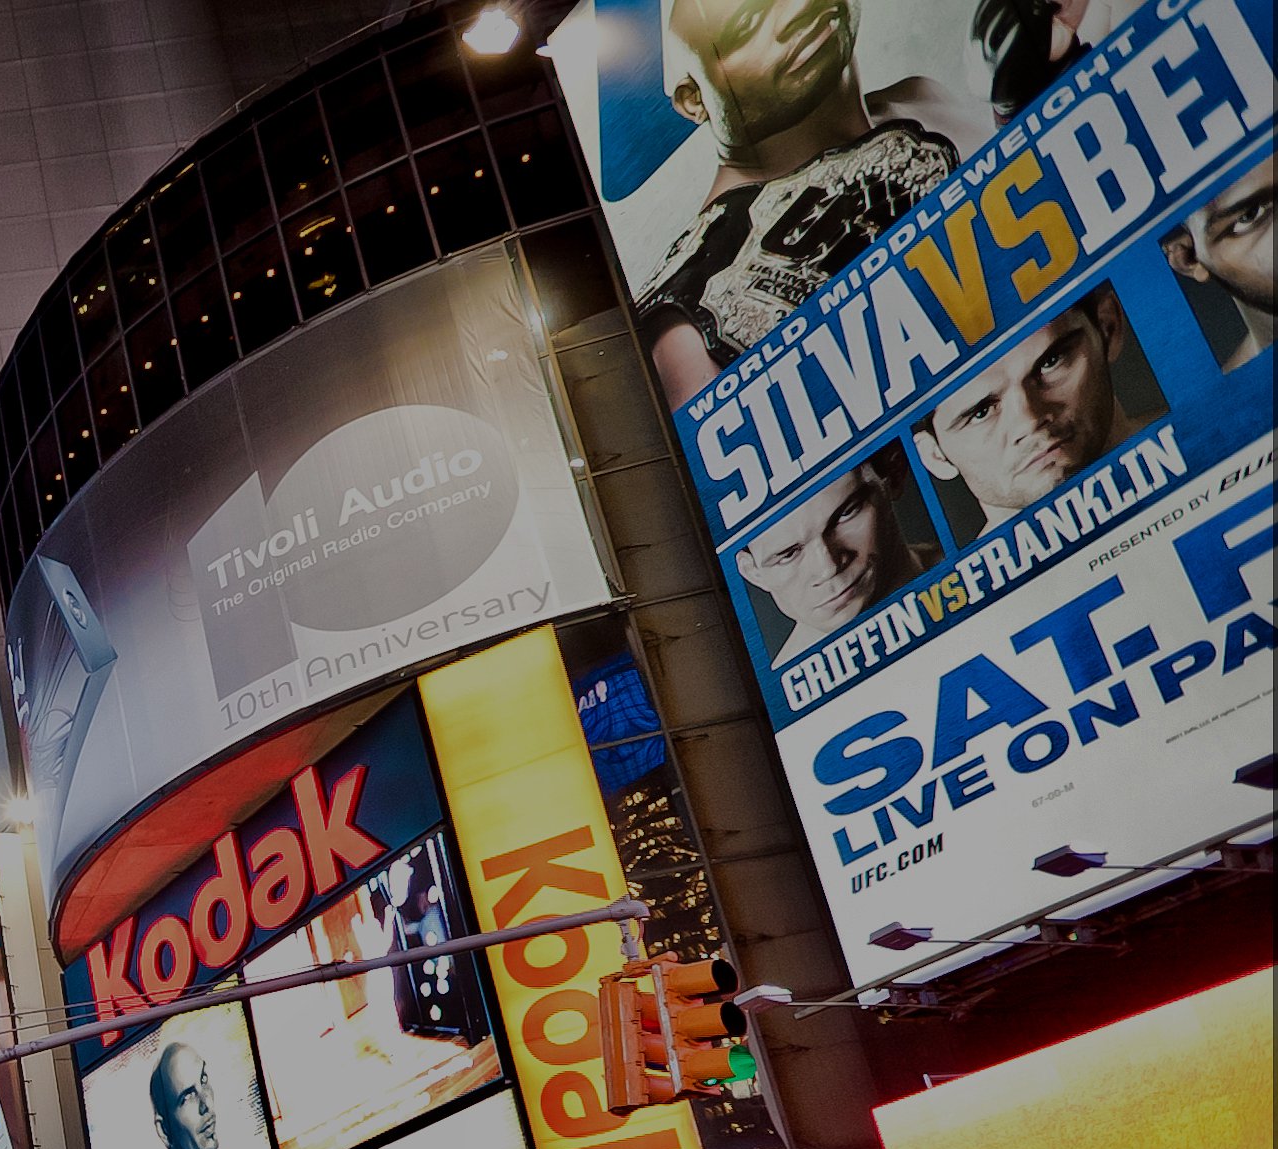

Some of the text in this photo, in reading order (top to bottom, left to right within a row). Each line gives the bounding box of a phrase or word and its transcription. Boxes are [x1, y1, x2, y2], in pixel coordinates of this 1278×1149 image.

[688, 22, 1139, 421] WORLD MIDDLEWEIGHT
[693, 265, 959, 530] SILVA
[909, 149, 1081, 347] VS
[207, 447, 482, 591] Tivoli Audio
[212, 478, 492, 617] The Original Radio Company
[779, 425, 1189, 713] GRIFFIN VS FRANKLIN
[1087, 508, 1184, 571] PRESENTED
[1189, 490, 1211, 514] BY
[221, 581, 553, 733] 10th Anniversary
[813, 494, 1273, 816] SAT. F
[832, 755, 996, 867] LIVE
[1006, 681, 1140, 774] ON
[850, 833, 945, 895] UFC.COM
[86, 764, 390, 1047] Kodak
